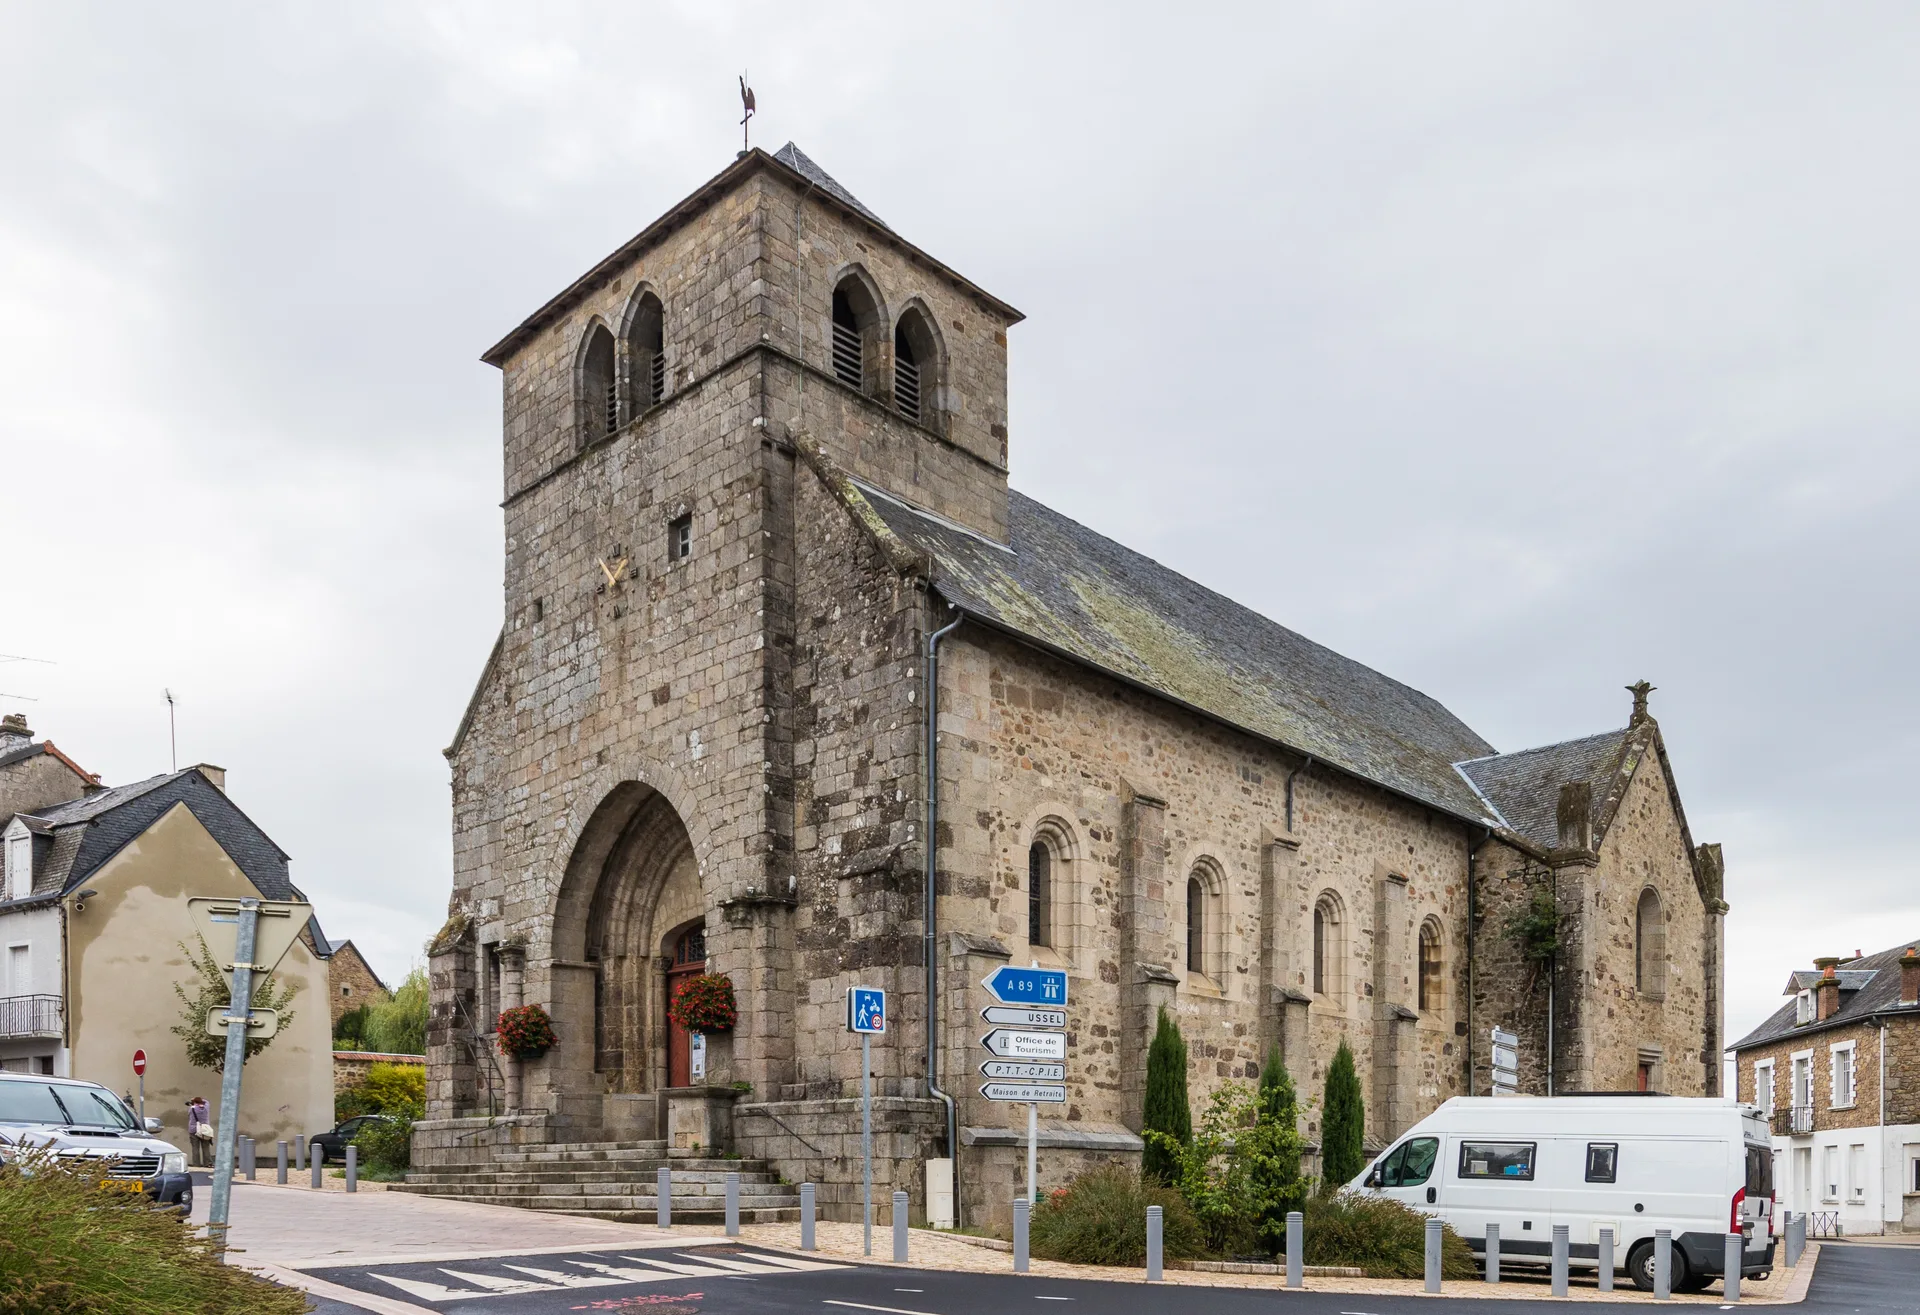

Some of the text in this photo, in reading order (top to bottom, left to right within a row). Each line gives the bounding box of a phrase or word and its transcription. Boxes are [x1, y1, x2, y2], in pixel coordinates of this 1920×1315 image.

[1008, 980, 1033, 992] A 89
[1028, 1014, 1061, 1024] USSEL
[1016, 1036, 1042, 1044] Office
[1016, 1046, 1056, 1054] Tourisme
[996, 1066, 1061, 1076] P.T.T.-C.P.I.E.
[1034, 1090, 1062, 1098] Retraite
